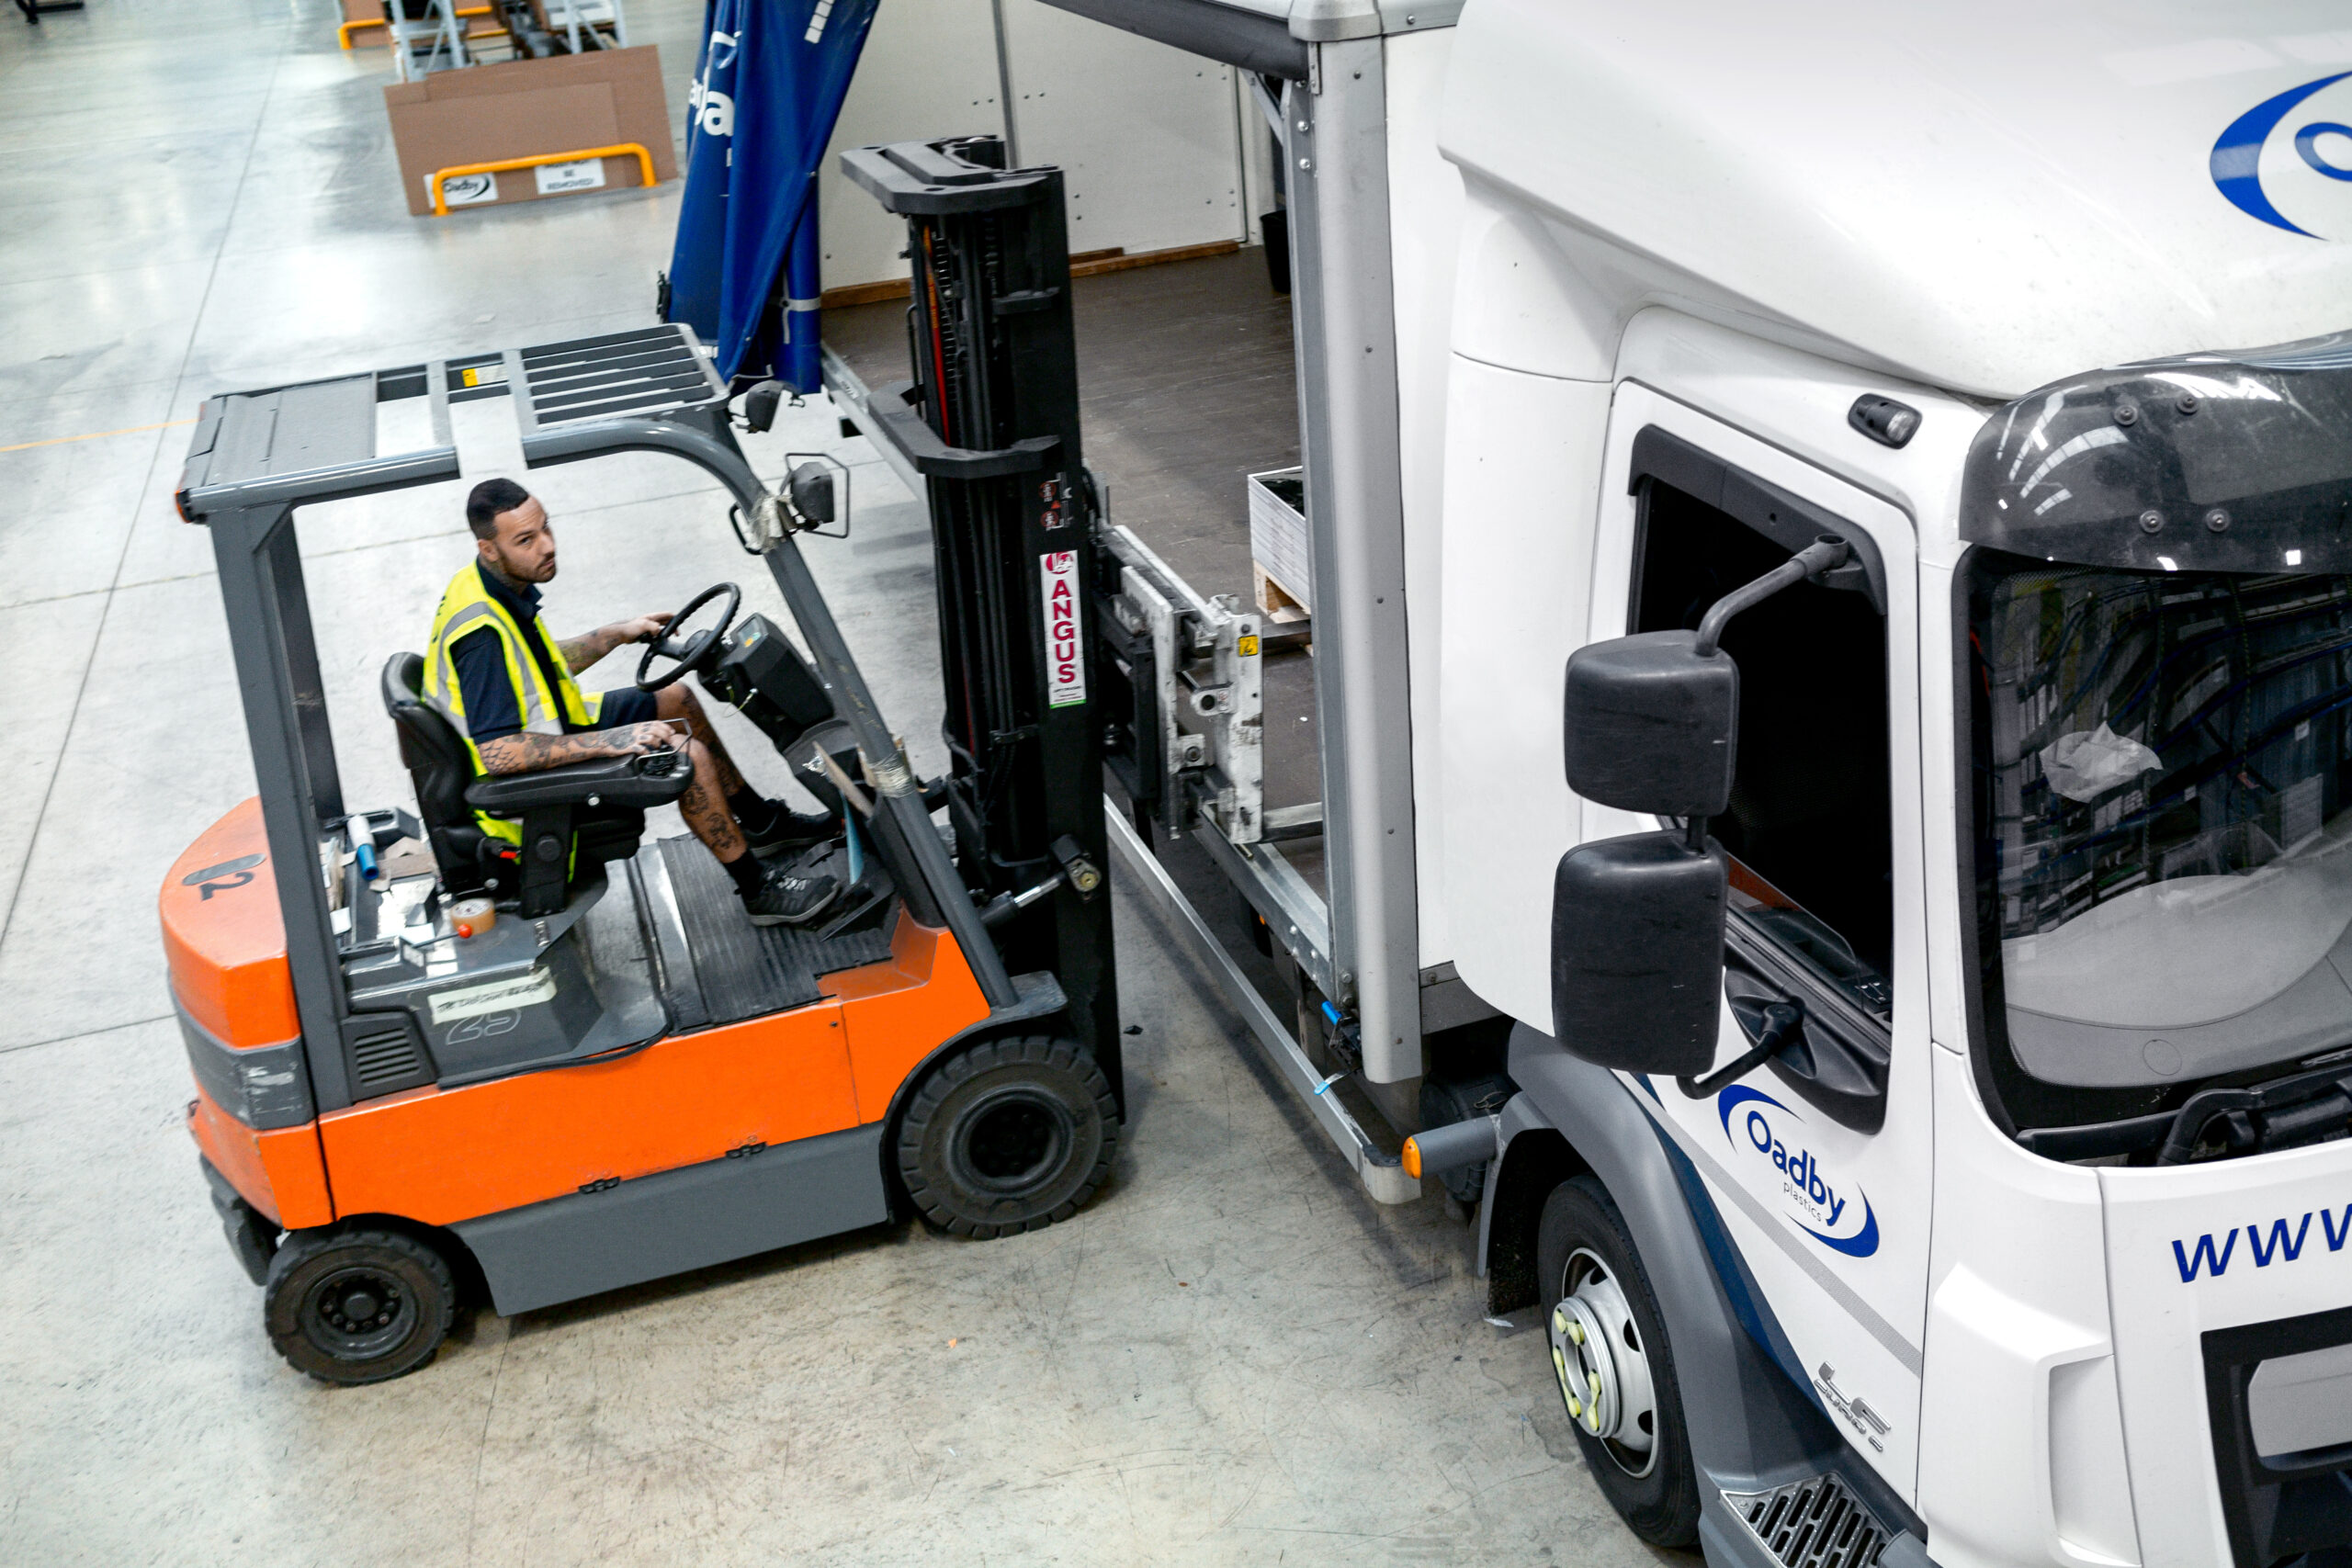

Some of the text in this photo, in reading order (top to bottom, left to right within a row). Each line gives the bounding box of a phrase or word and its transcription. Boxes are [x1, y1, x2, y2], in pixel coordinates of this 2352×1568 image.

[1051, 579, 1076, 684] ANGUS
[1747, 1110, 1846, 1227] Oadby
[1783, 1181, 1822, 1223] plastics
[1818, 1360, 1892, 1435] LF
